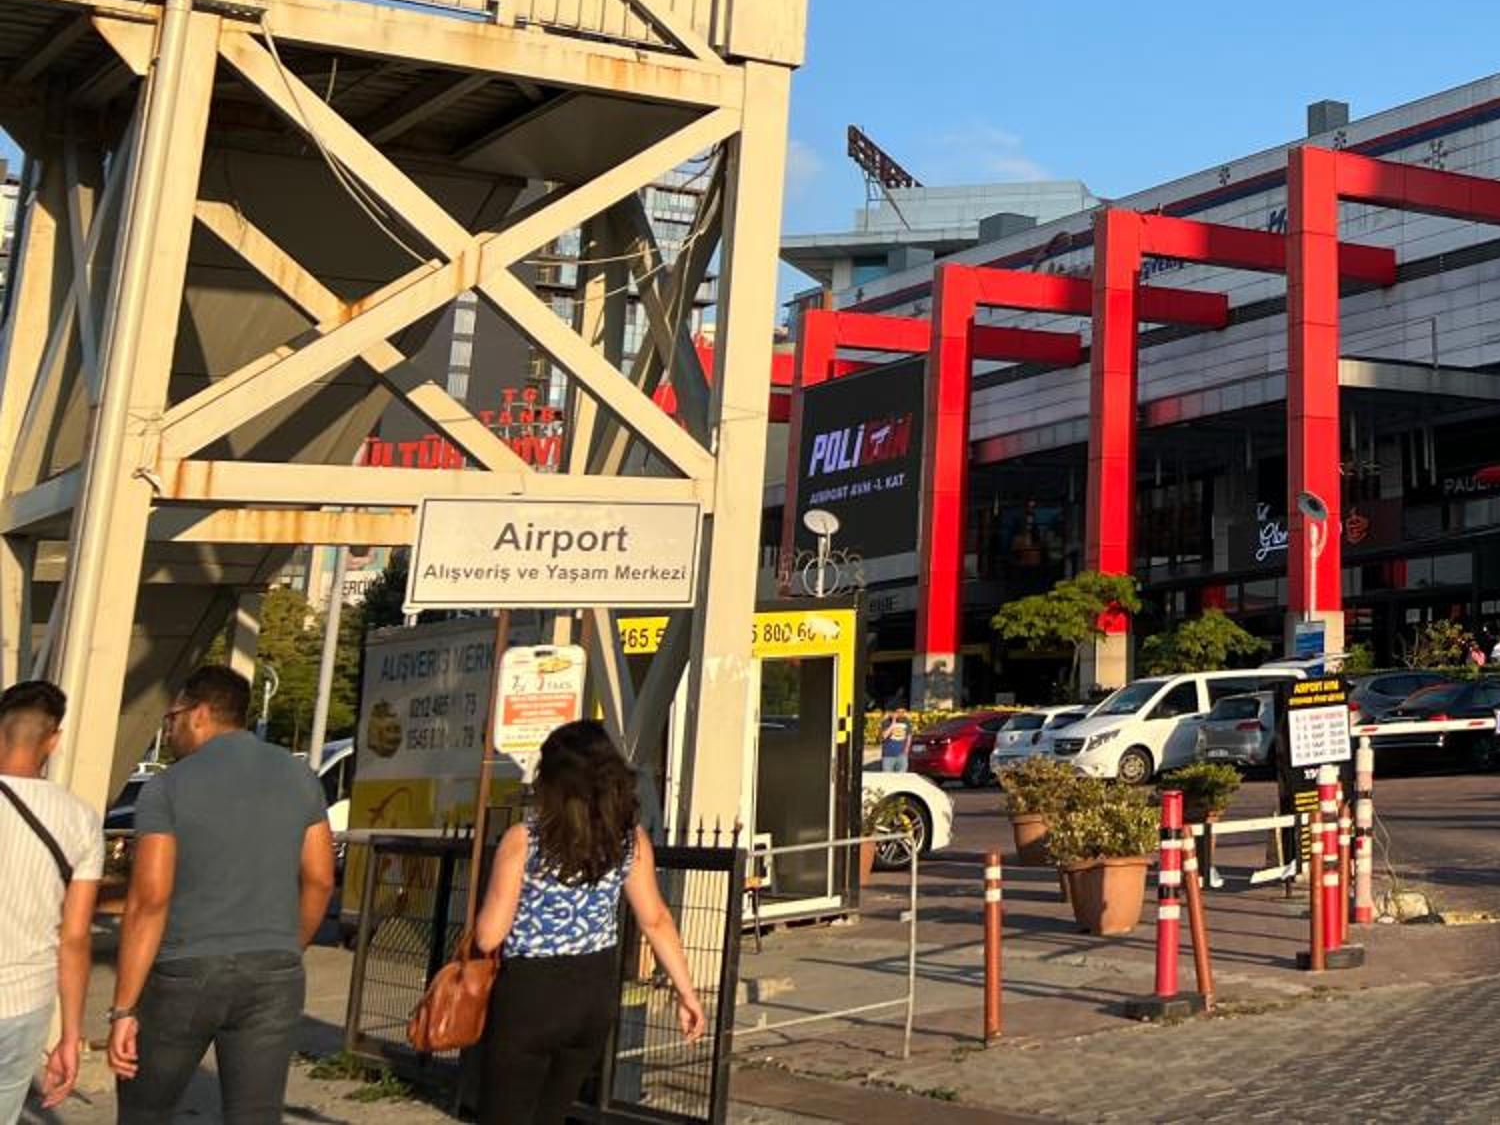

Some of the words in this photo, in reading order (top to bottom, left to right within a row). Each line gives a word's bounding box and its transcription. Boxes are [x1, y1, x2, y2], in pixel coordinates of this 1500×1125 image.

[493, 523, 629, 558] Airport
[424, 564, 510, 583] Alışveriş
[517, 568, 539, 580] ve
[546, 564, 609, 583] Yaşam
[615, 564, 686, 580] Merkezi
